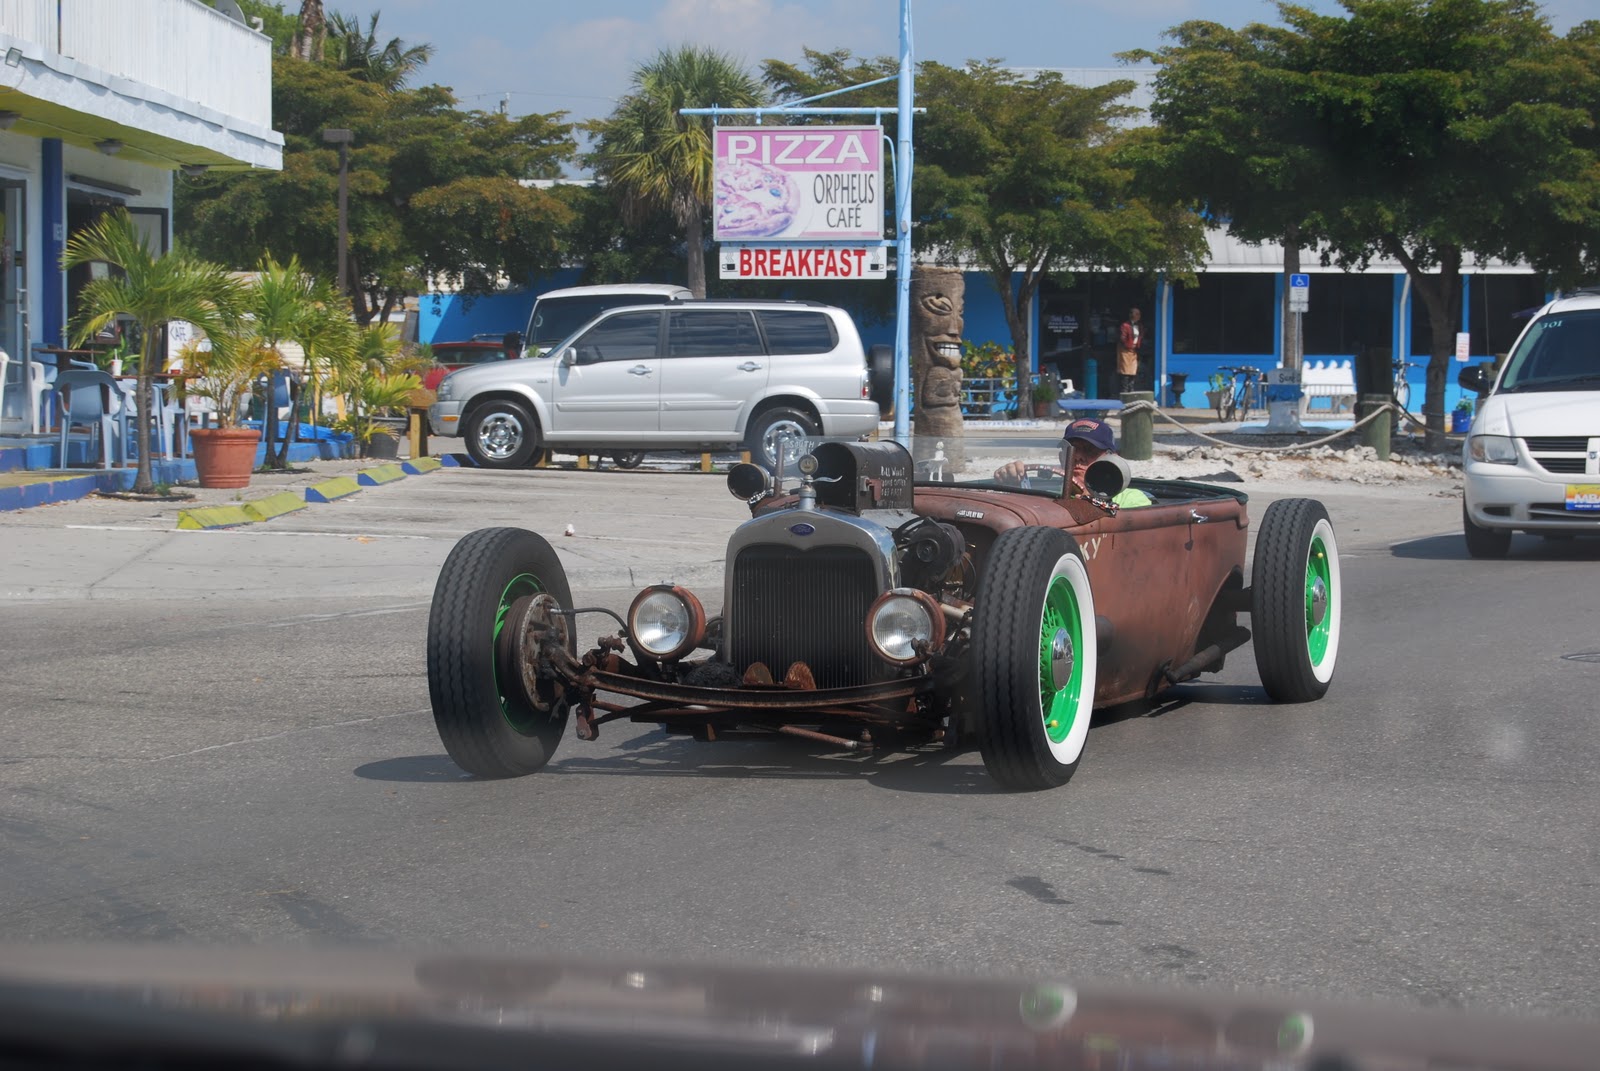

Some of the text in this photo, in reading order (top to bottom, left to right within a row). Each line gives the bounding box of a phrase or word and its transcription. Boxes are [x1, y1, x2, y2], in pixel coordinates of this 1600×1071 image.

[727, 134, 870, 165] PIZZA
[813, 173, 875, 204] ORPHEUS
[826, 203, 862, 228] CAFÉ
[739, 248, 867, 277] BREAKFAST
[1574, 493, 1600, 503] MB
